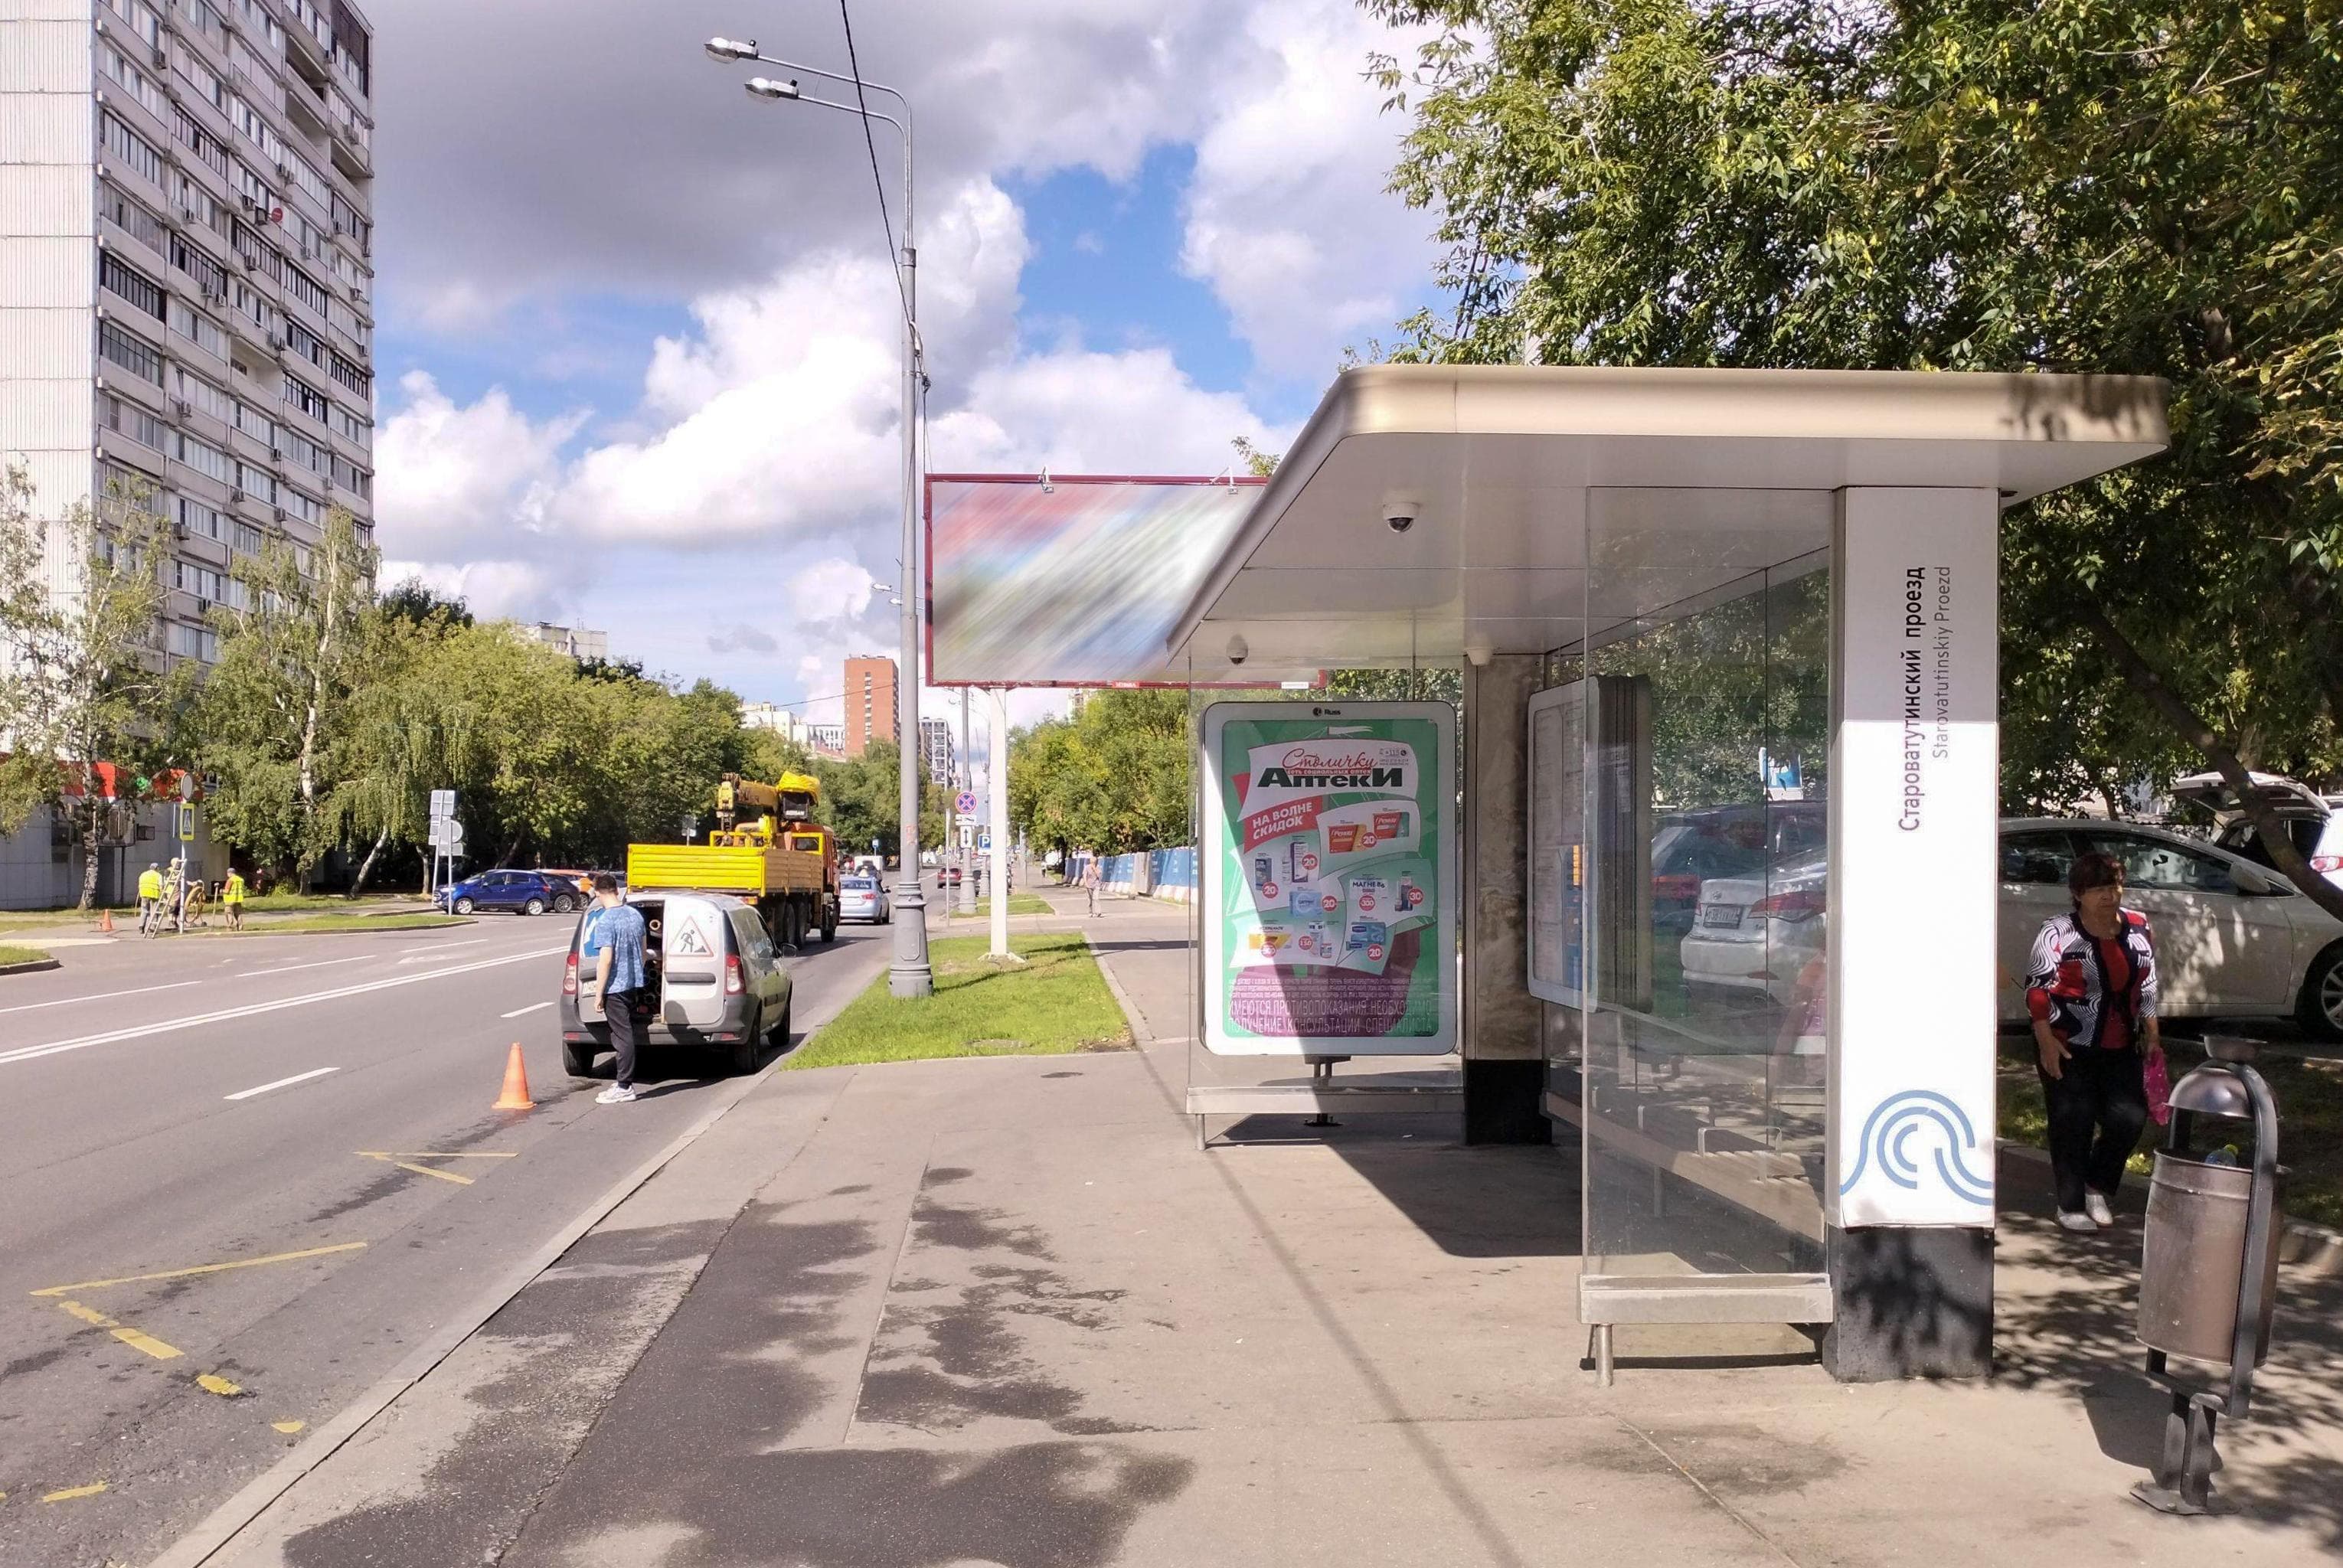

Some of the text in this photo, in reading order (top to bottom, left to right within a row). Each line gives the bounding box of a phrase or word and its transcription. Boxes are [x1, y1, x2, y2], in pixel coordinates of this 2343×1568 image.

[1933, 567, 1953, 758] Starovatutinskiy Proezd
[1898, 567, 1926, 831] Староватутинский проезд
[1283, 748, 1377, 768] Столички
[1253, 802, 1312, 828] НА ВОЛНЕ
[1253, 815, 1302, 840] СКИДОК
[982, 836, 990, 847] P
[1230, 1000, 1271, 1015] ИМЕЮТСЯ
[1228, 1018, 1284, 1033] ПОЛУЧЕНИЕ
[1288, 1018, 1360, 1033] КОНСУЛЬТАЦИИ
